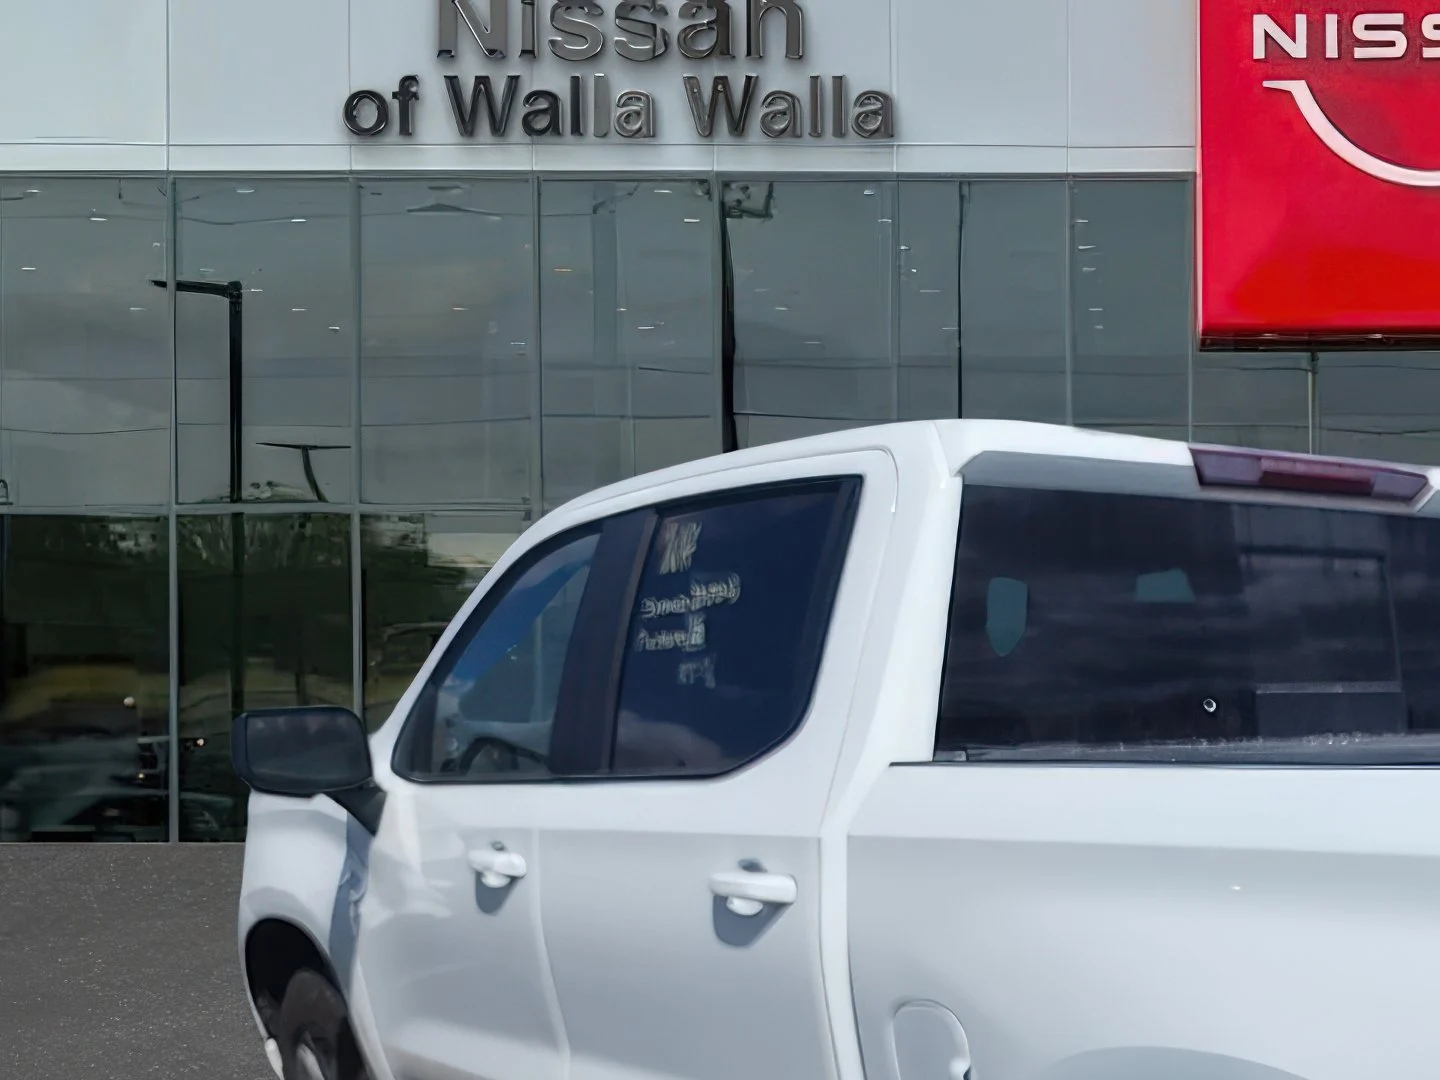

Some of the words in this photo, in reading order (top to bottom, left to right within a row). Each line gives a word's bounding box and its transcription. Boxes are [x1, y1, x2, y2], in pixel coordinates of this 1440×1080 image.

[437, 0, 804, 61] Nissan
[342, 74, 420, 138] of
[443, 74, 657, 138] Walla
[683, 74, 896, 139] Walla
